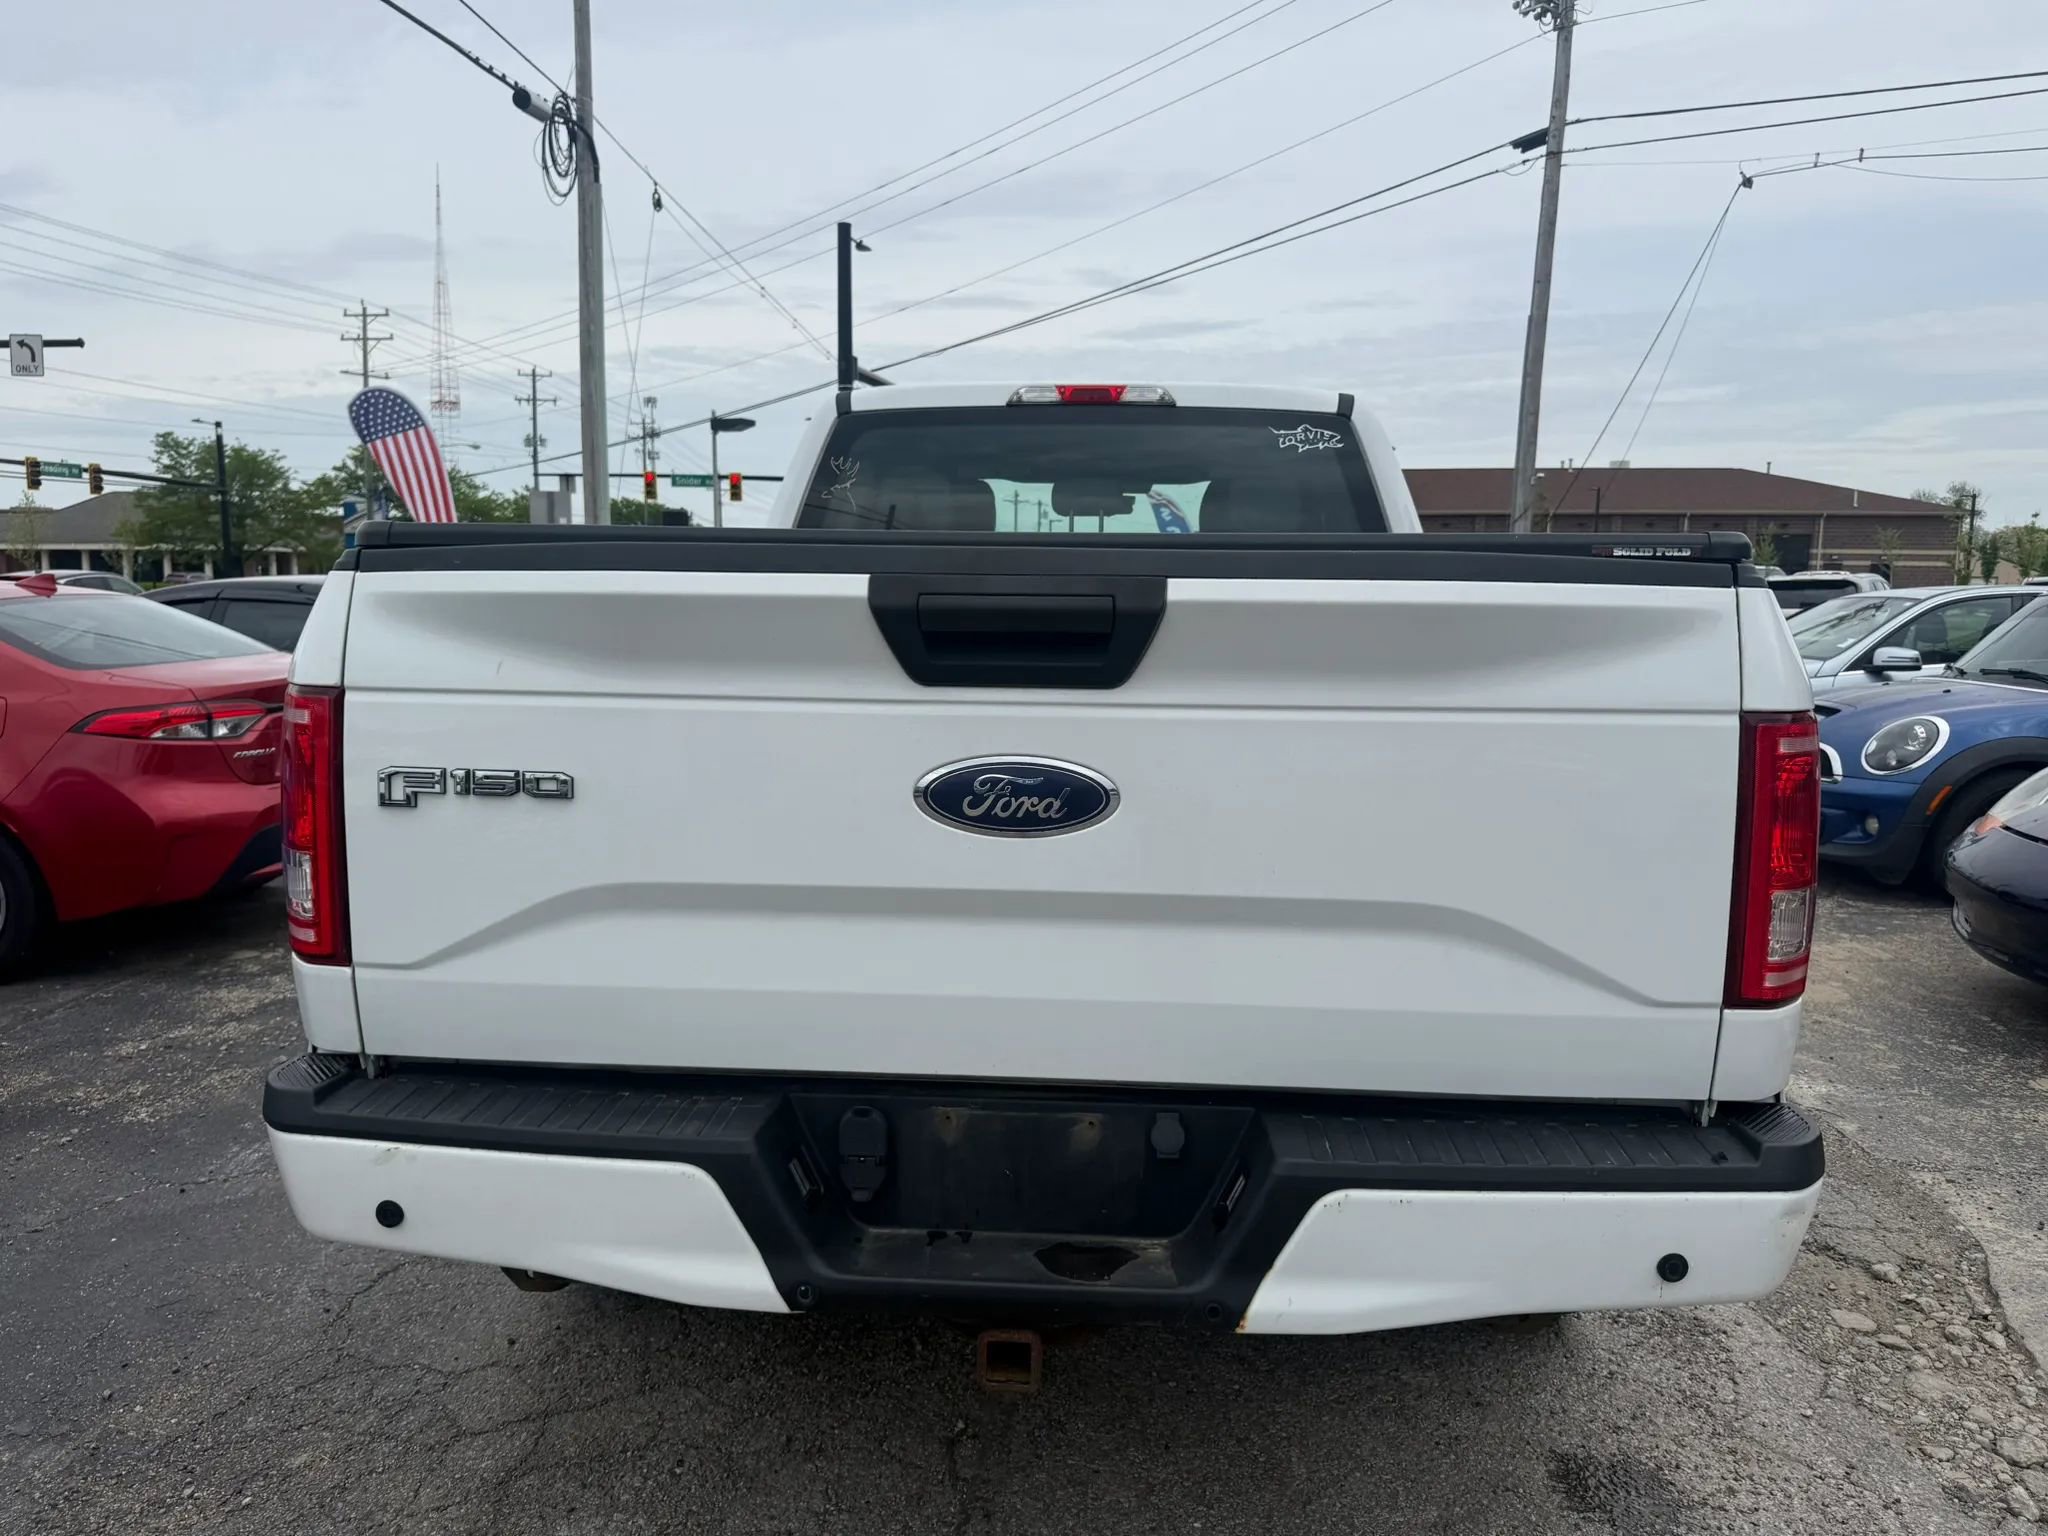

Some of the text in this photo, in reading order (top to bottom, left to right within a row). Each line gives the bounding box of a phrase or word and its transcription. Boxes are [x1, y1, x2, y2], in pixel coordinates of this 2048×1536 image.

[15, 364, 39, 374] ONLY
[1285, 431, 1330, 444] ORVIS
[675, 476, 702, 486] Snider
[1612, 547, 1692, 556] SOLID FOLD
[962, 773, 1071, 818] Ford
